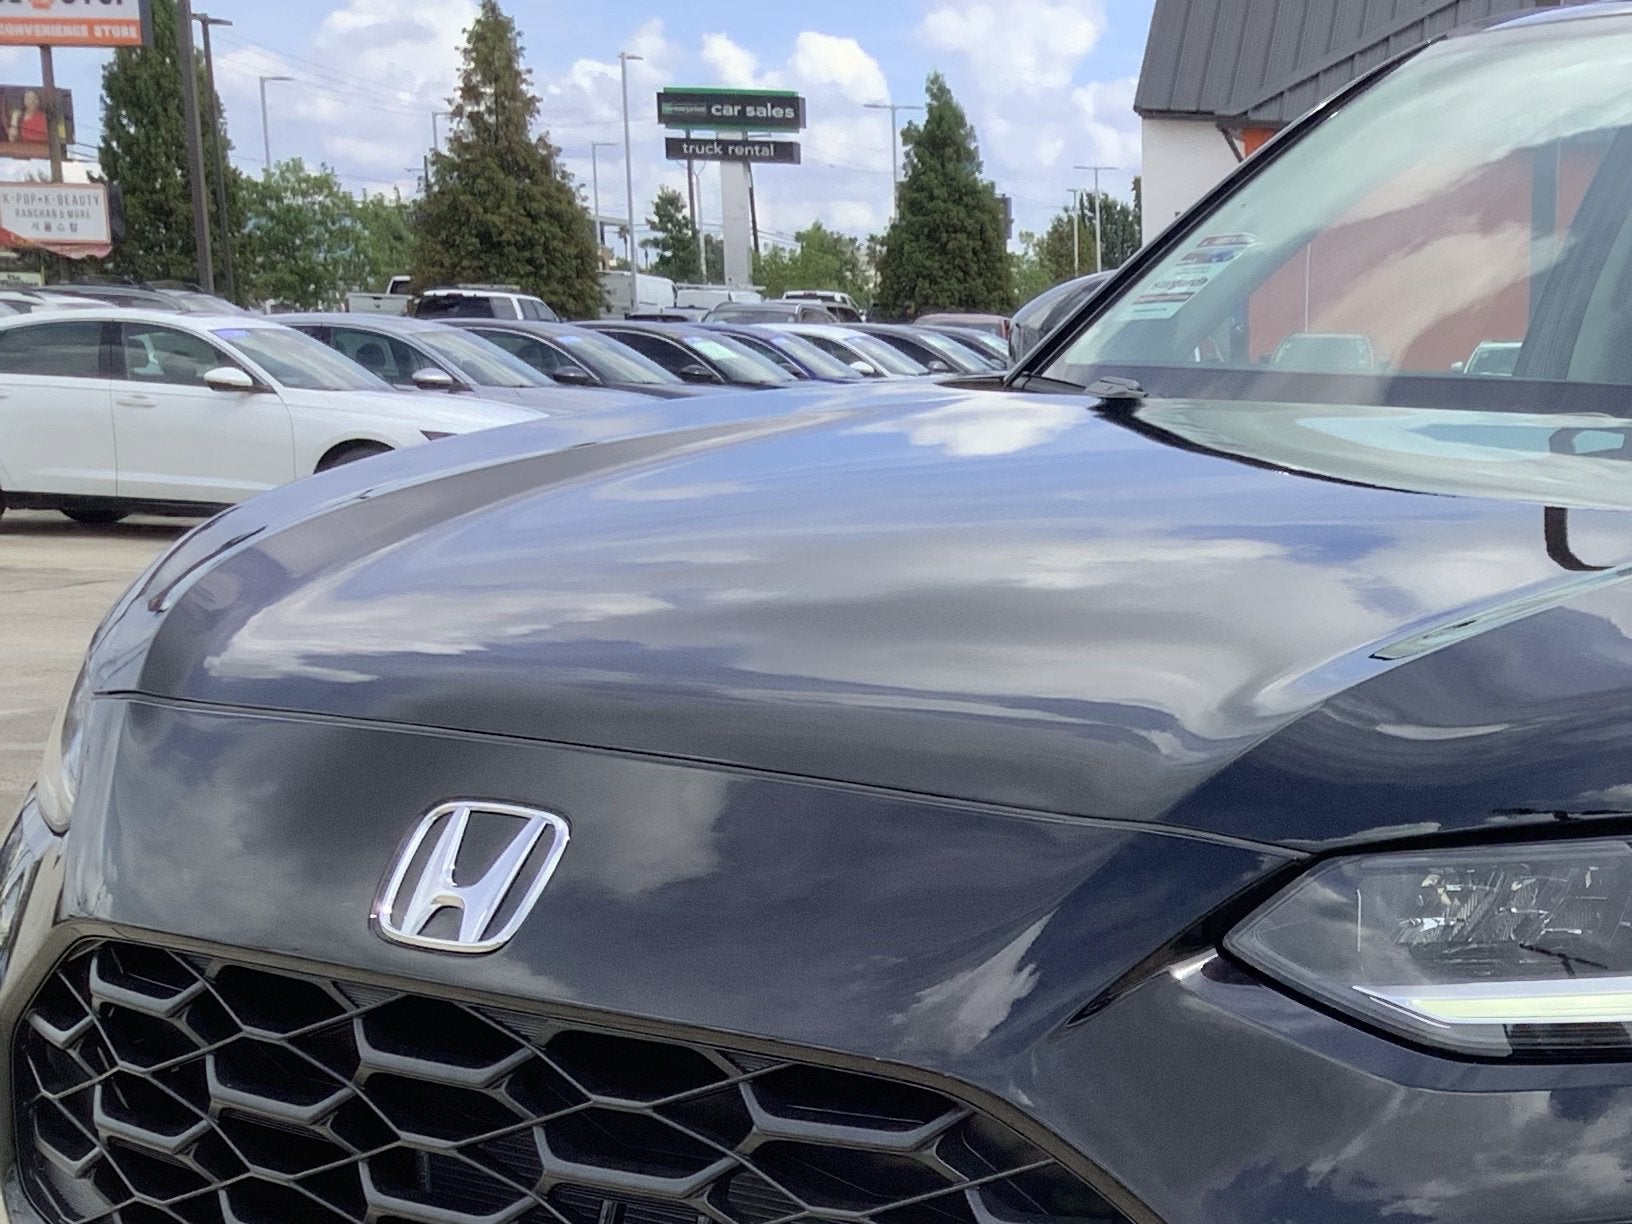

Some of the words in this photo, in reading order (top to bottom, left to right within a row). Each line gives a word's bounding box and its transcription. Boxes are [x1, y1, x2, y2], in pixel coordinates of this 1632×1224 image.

[93, 25, 137, 38] STORE
[711, 103, 742, 116] car
[745, 102, 795, 118] sales
[682, 141, 723, 154] truck
[728, 143, 775, 157] rental
